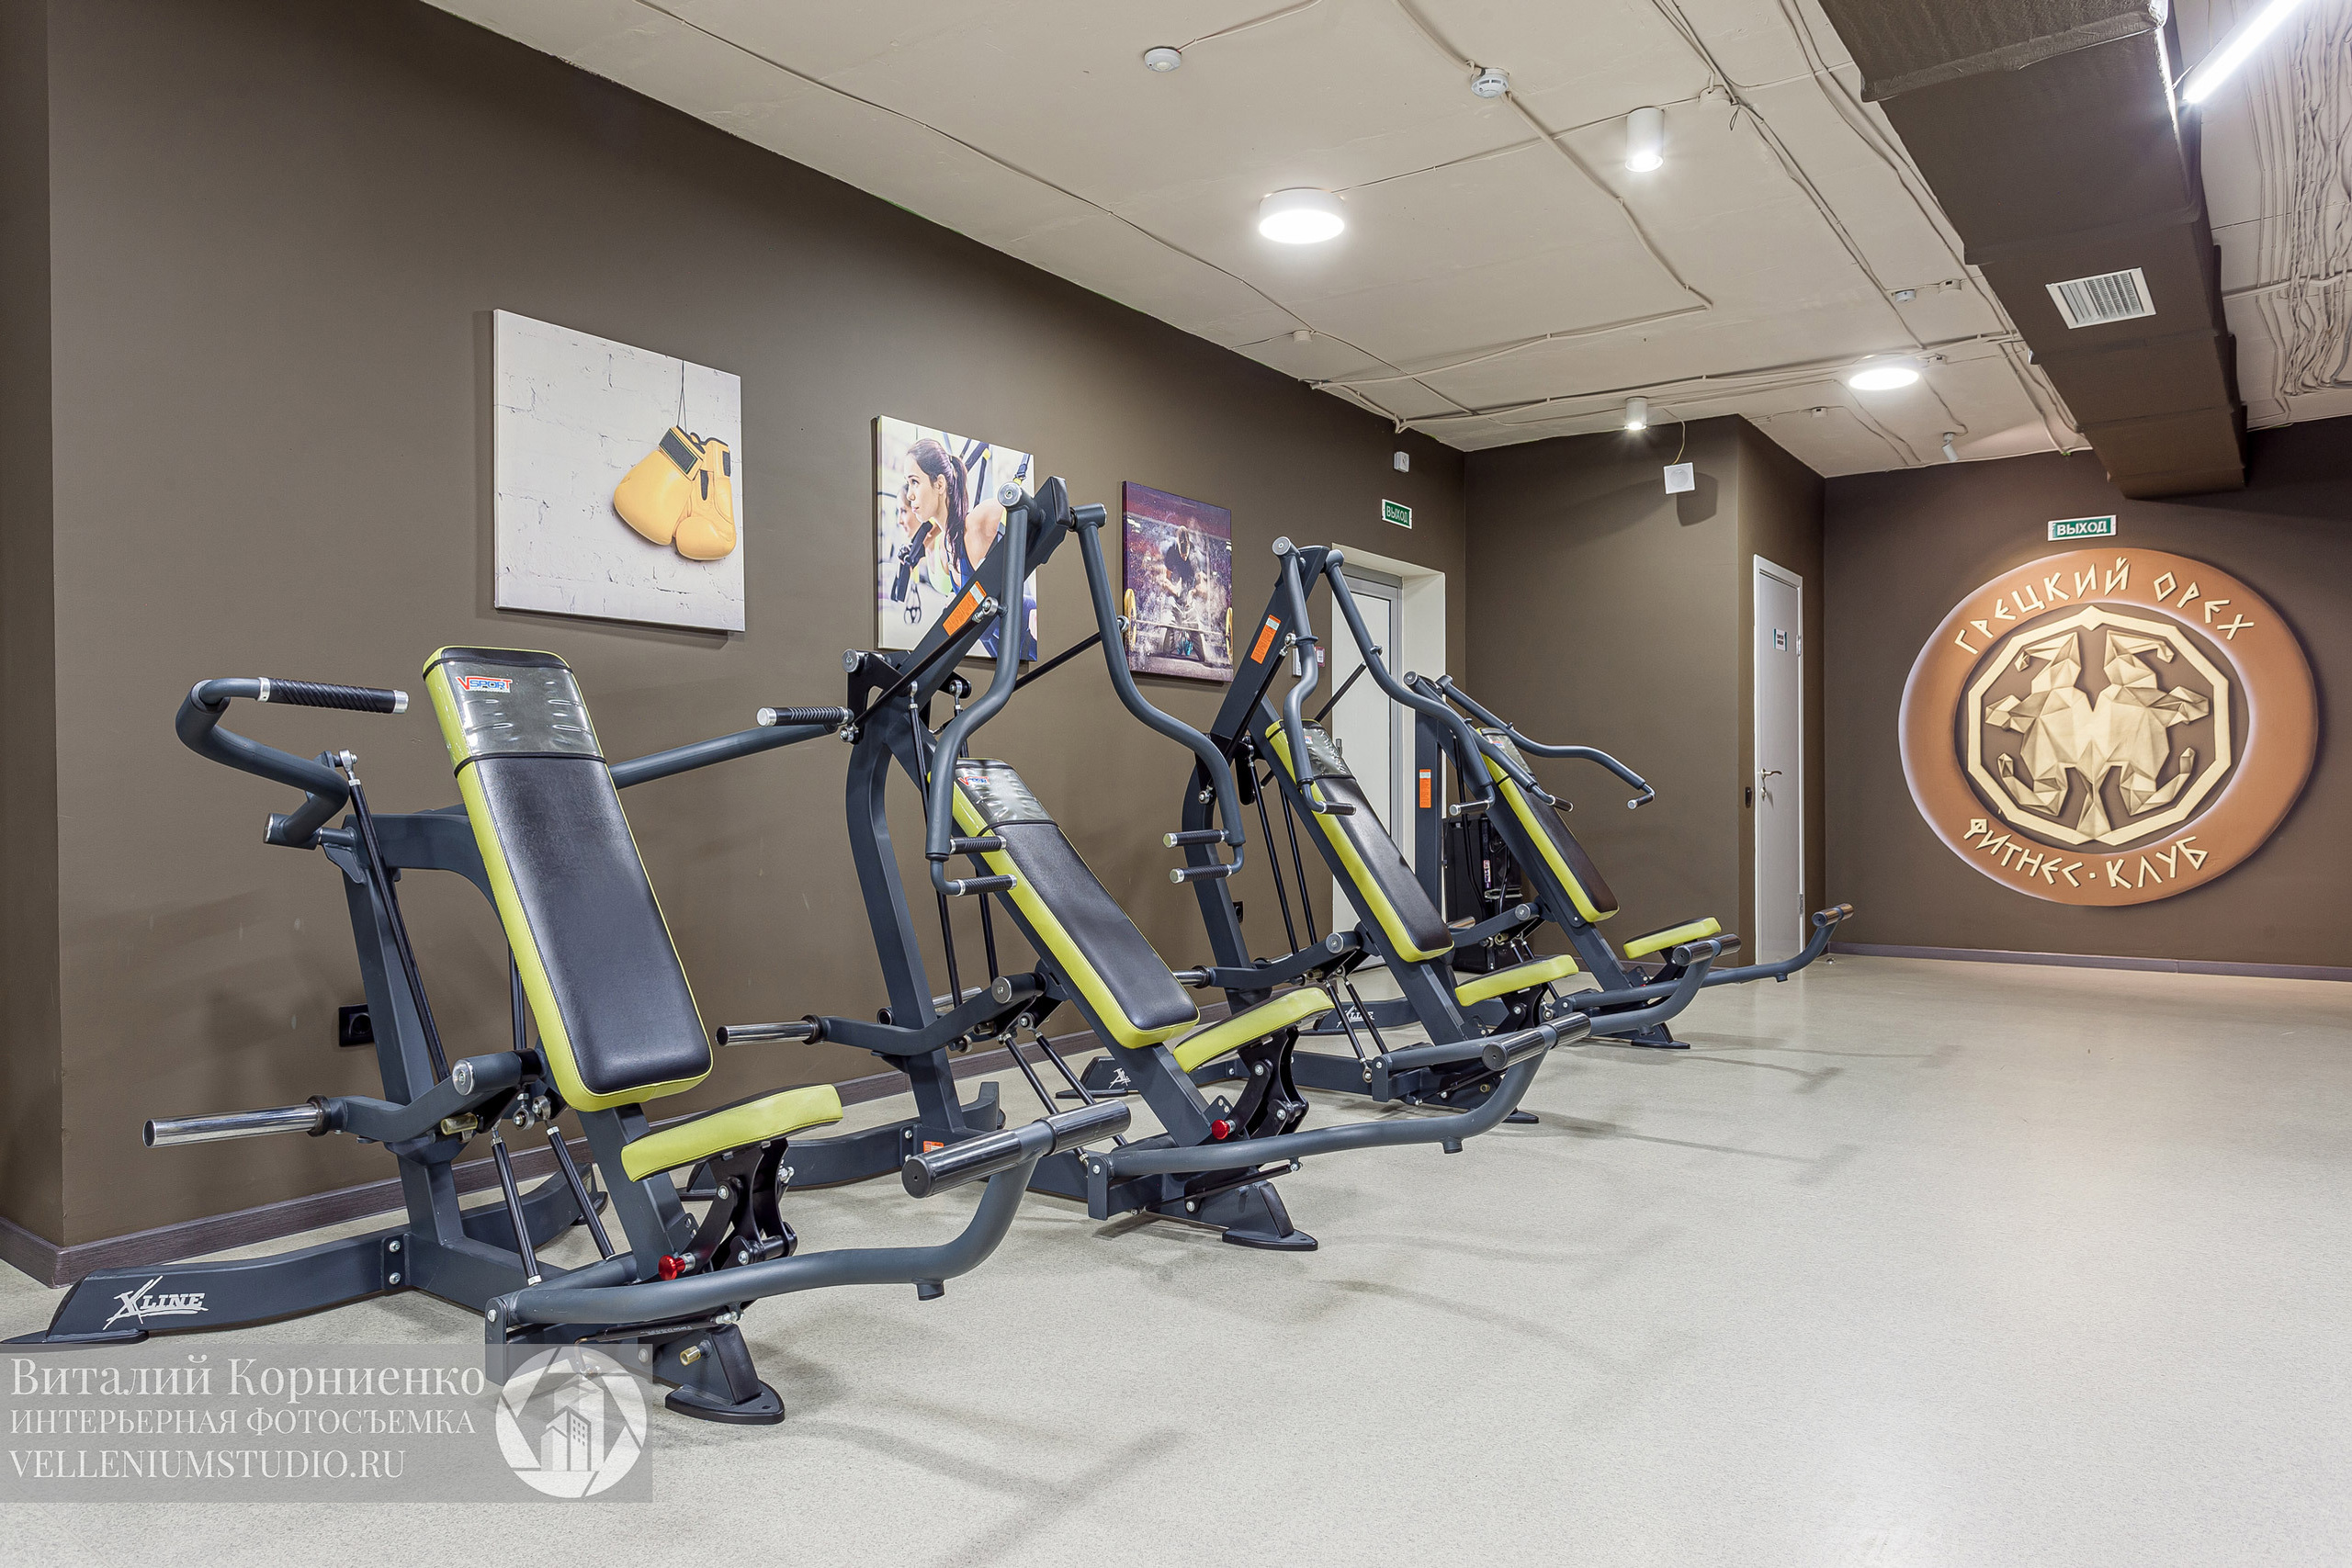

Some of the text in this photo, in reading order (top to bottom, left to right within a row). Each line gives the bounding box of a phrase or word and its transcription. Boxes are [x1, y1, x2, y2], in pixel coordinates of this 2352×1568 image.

[1386, 505, 1408, 524] ВЫХОД
[2057, 521, 2108, 536] ВЫХОД
[1954, 557, 2255, 654] ГРЕЦКИЙ ОРЕХ
[456, 676, 512, 691] VSPORT
